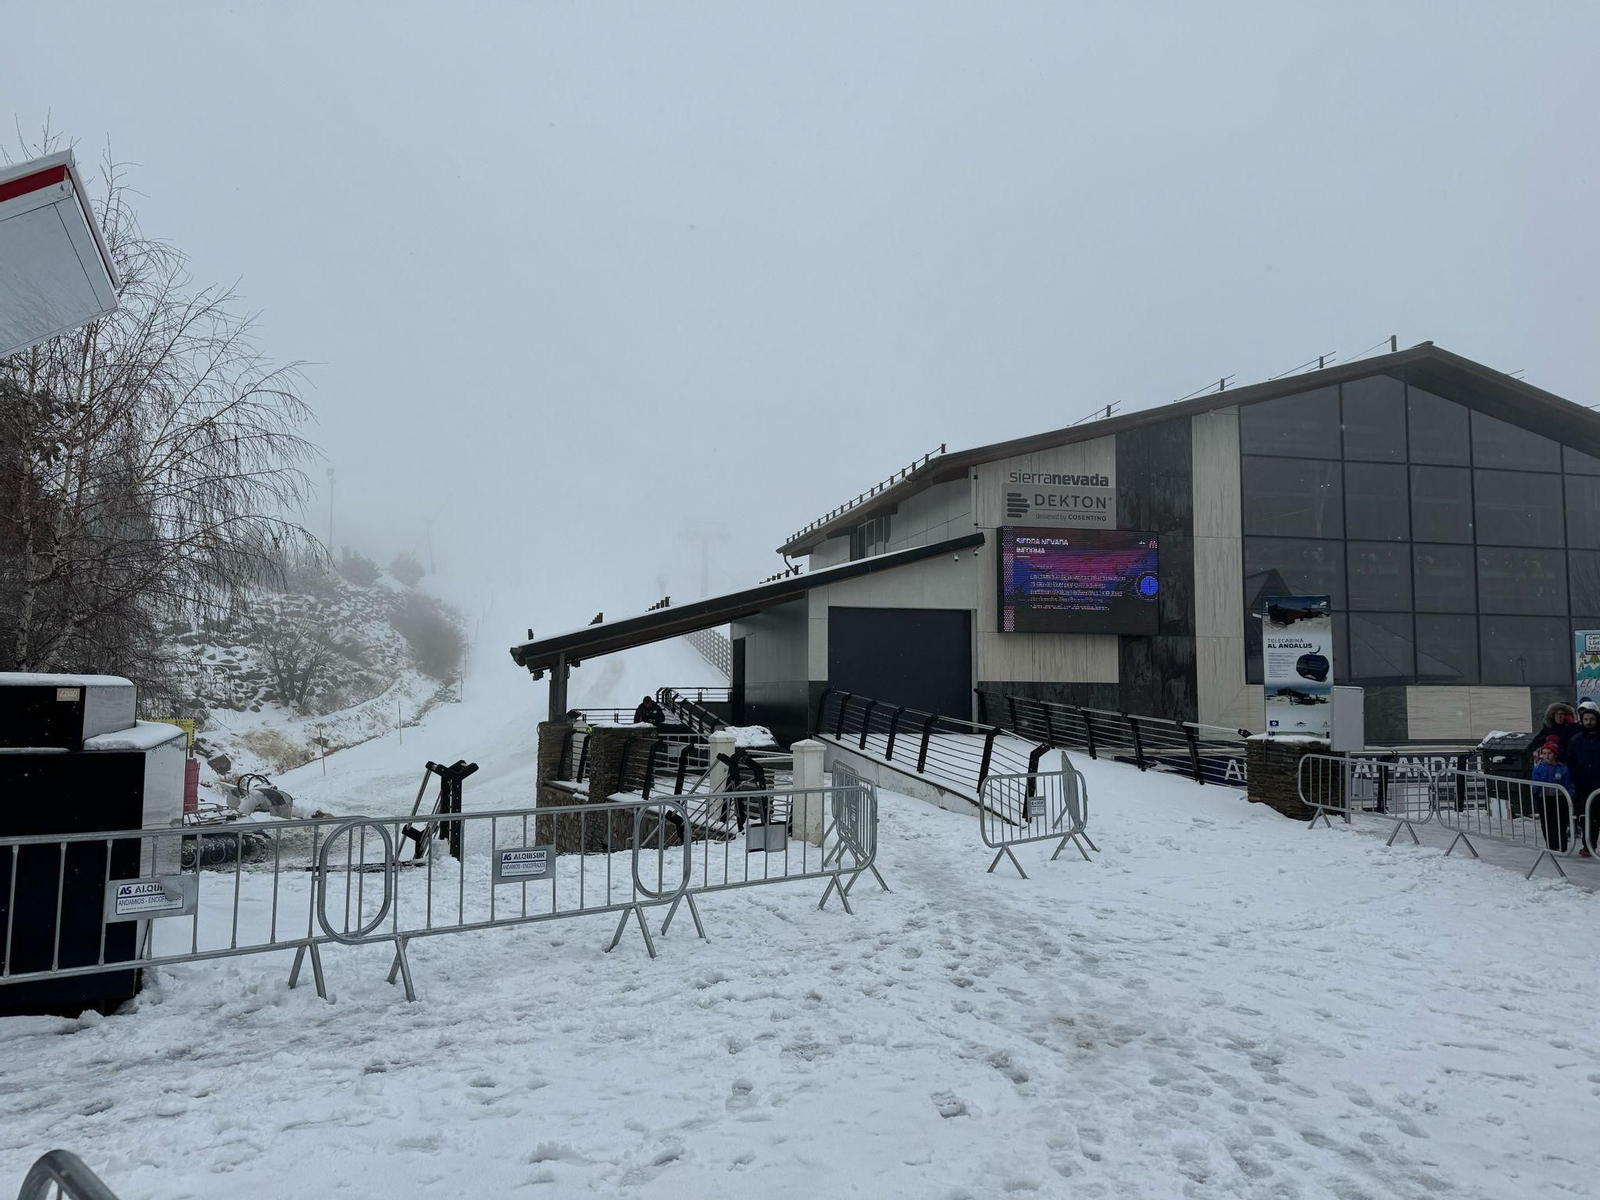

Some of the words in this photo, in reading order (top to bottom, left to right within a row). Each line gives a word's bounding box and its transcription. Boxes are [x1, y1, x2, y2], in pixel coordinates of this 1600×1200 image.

[1009, 469, 1109, 487] sierranevada
[1035, 513, 1060, 521] designed
[1068, 514, 1107, 522] COSENTINO
[503, 853, 512, 861] AS
[513, 852, 545, 860] ALQUISUR
[119, 886, 132, 896] AS
[118, 897, 145, 906] ANDAMIOS
